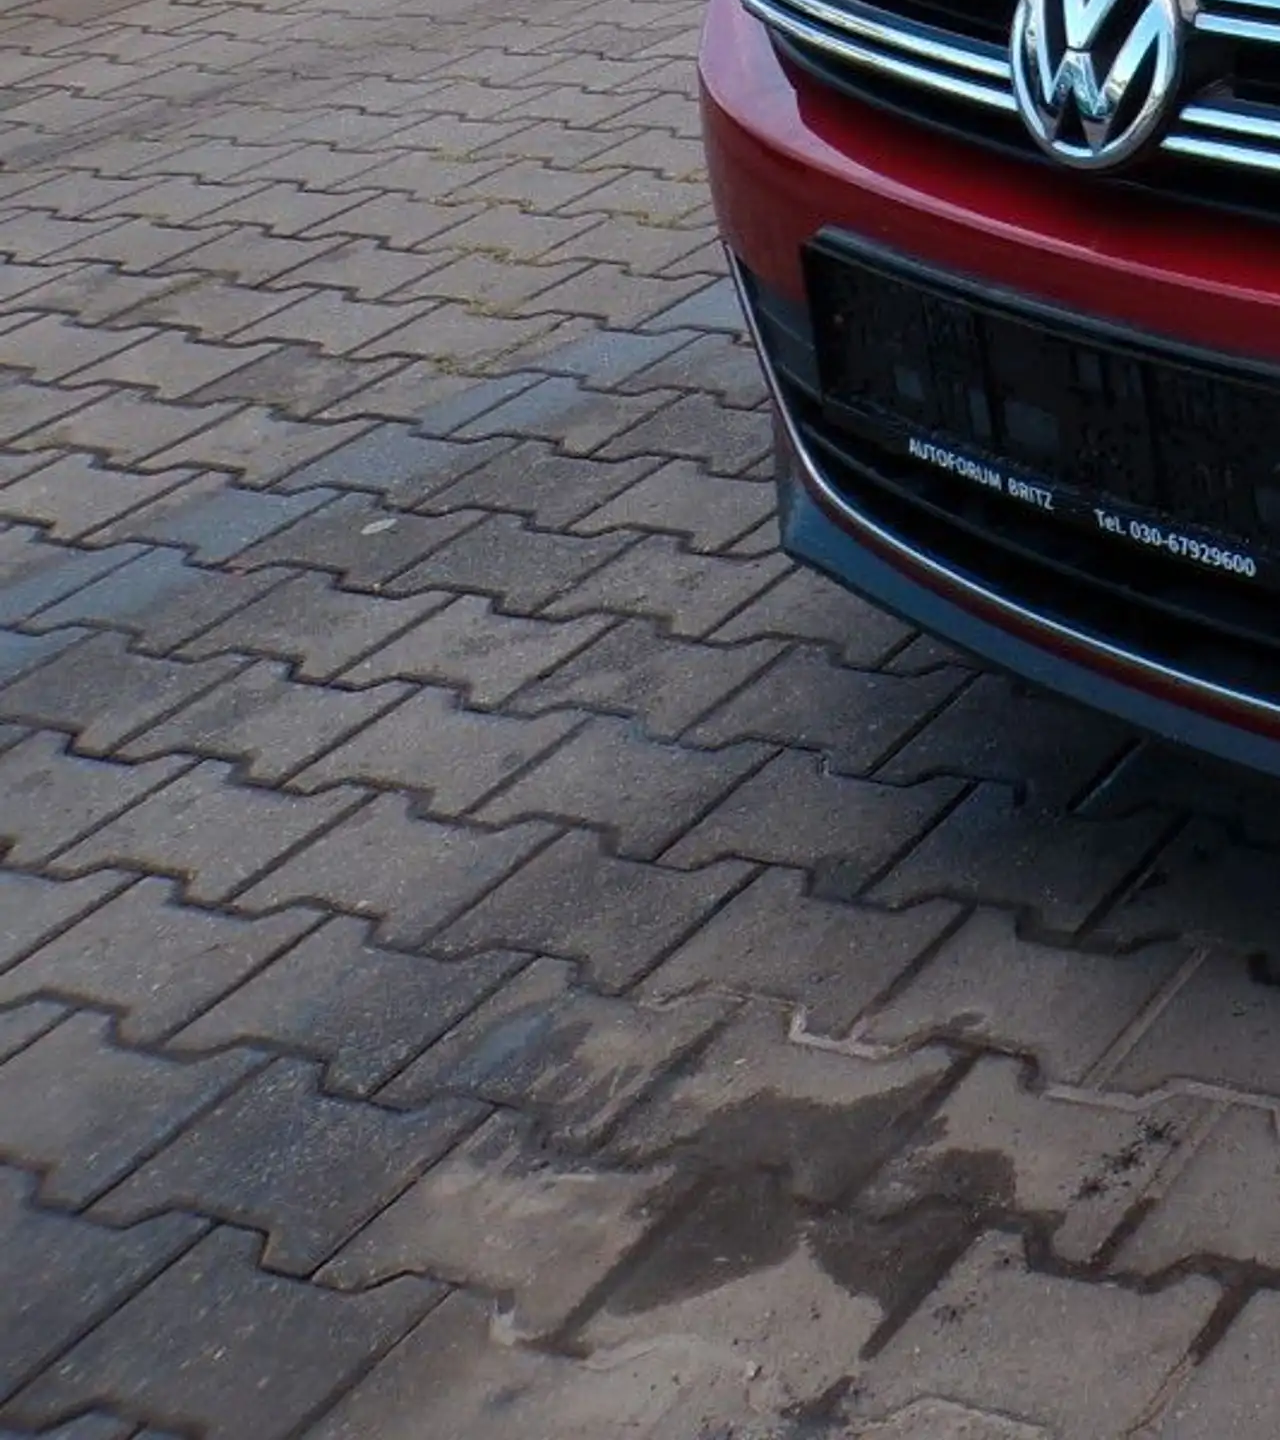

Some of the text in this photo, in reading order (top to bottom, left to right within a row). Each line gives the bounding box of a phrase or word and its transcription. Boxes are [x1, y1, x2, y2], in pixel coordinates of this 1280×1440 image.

[909, 437, 1002, 492] AUTOFORUM
[1008, 477, 1055, 511] BRITZ
[1129, 519, 1257, 577] 030-67929600
